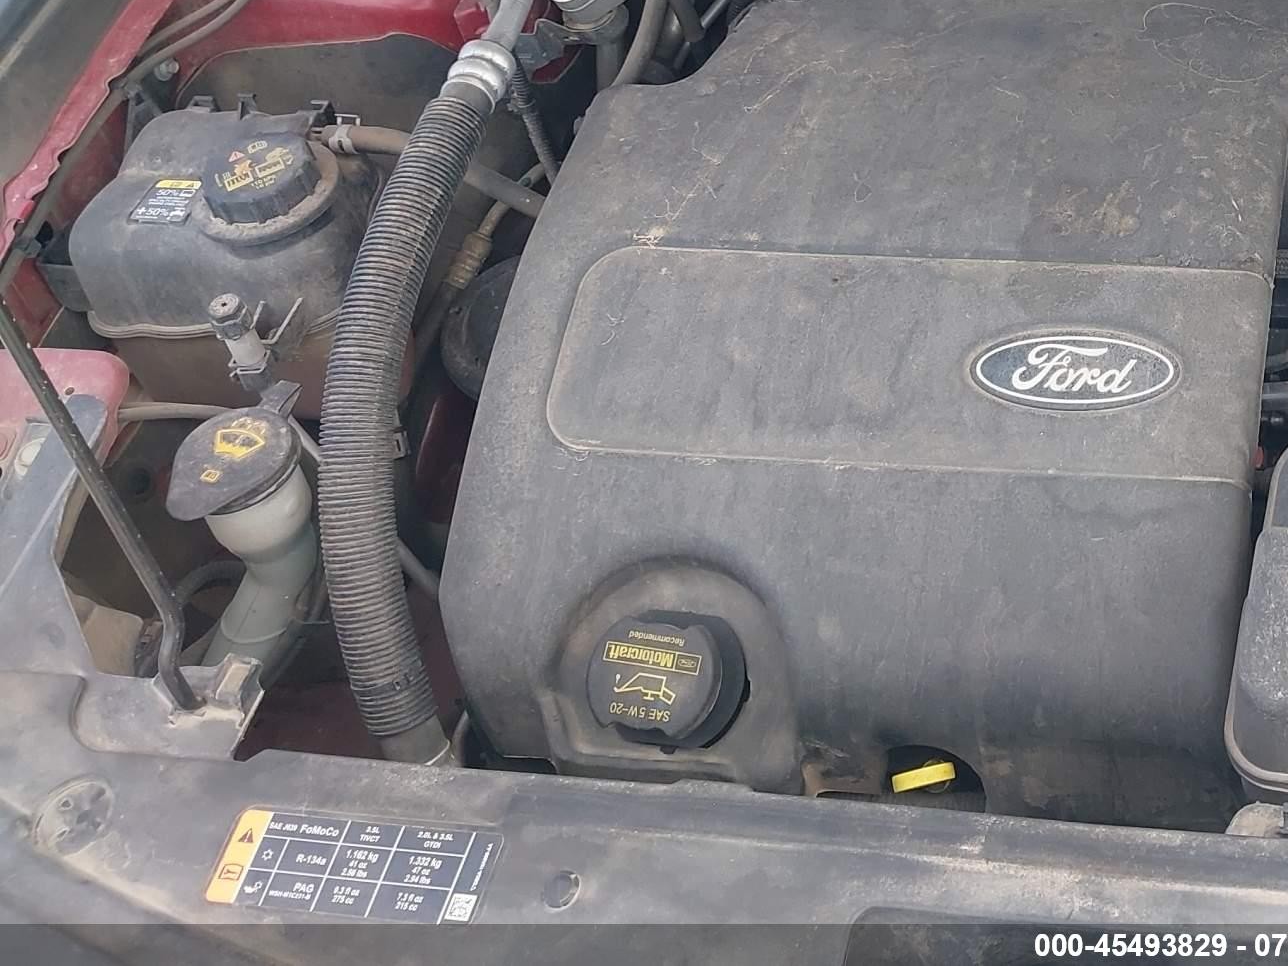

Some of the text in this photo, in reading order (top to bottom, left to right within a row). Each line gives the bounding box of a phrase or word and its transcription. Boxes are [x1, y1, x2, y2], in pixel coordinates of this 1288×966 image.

[1011, 343, 1139, 394] Ford
[628, 630, 685, 647] Recommended
[608, 644, 674, 668] Motorcraft
[609, 701, 671, 722] SAE 5W-20
[299, 823, 340, 837] FoMoCo
[295, 853, 328, 866] R-134a
[367, 851, 379, 863] kg
[408, 855, 443, 869] 1.332 kg
[358, 861, 368, 869] oz
[411, 866, 431, 876] 47 oz
[356, 869, 368, 878] lbs
[419, 875, 431, 885] lbs
[293, 882, 315, 894] PAG
[350, 888, 361, 897] oz
[345, 896, 355, 905] cc
[414, 895, 424, 904] oz
[408, 902, 418, 911] cc
